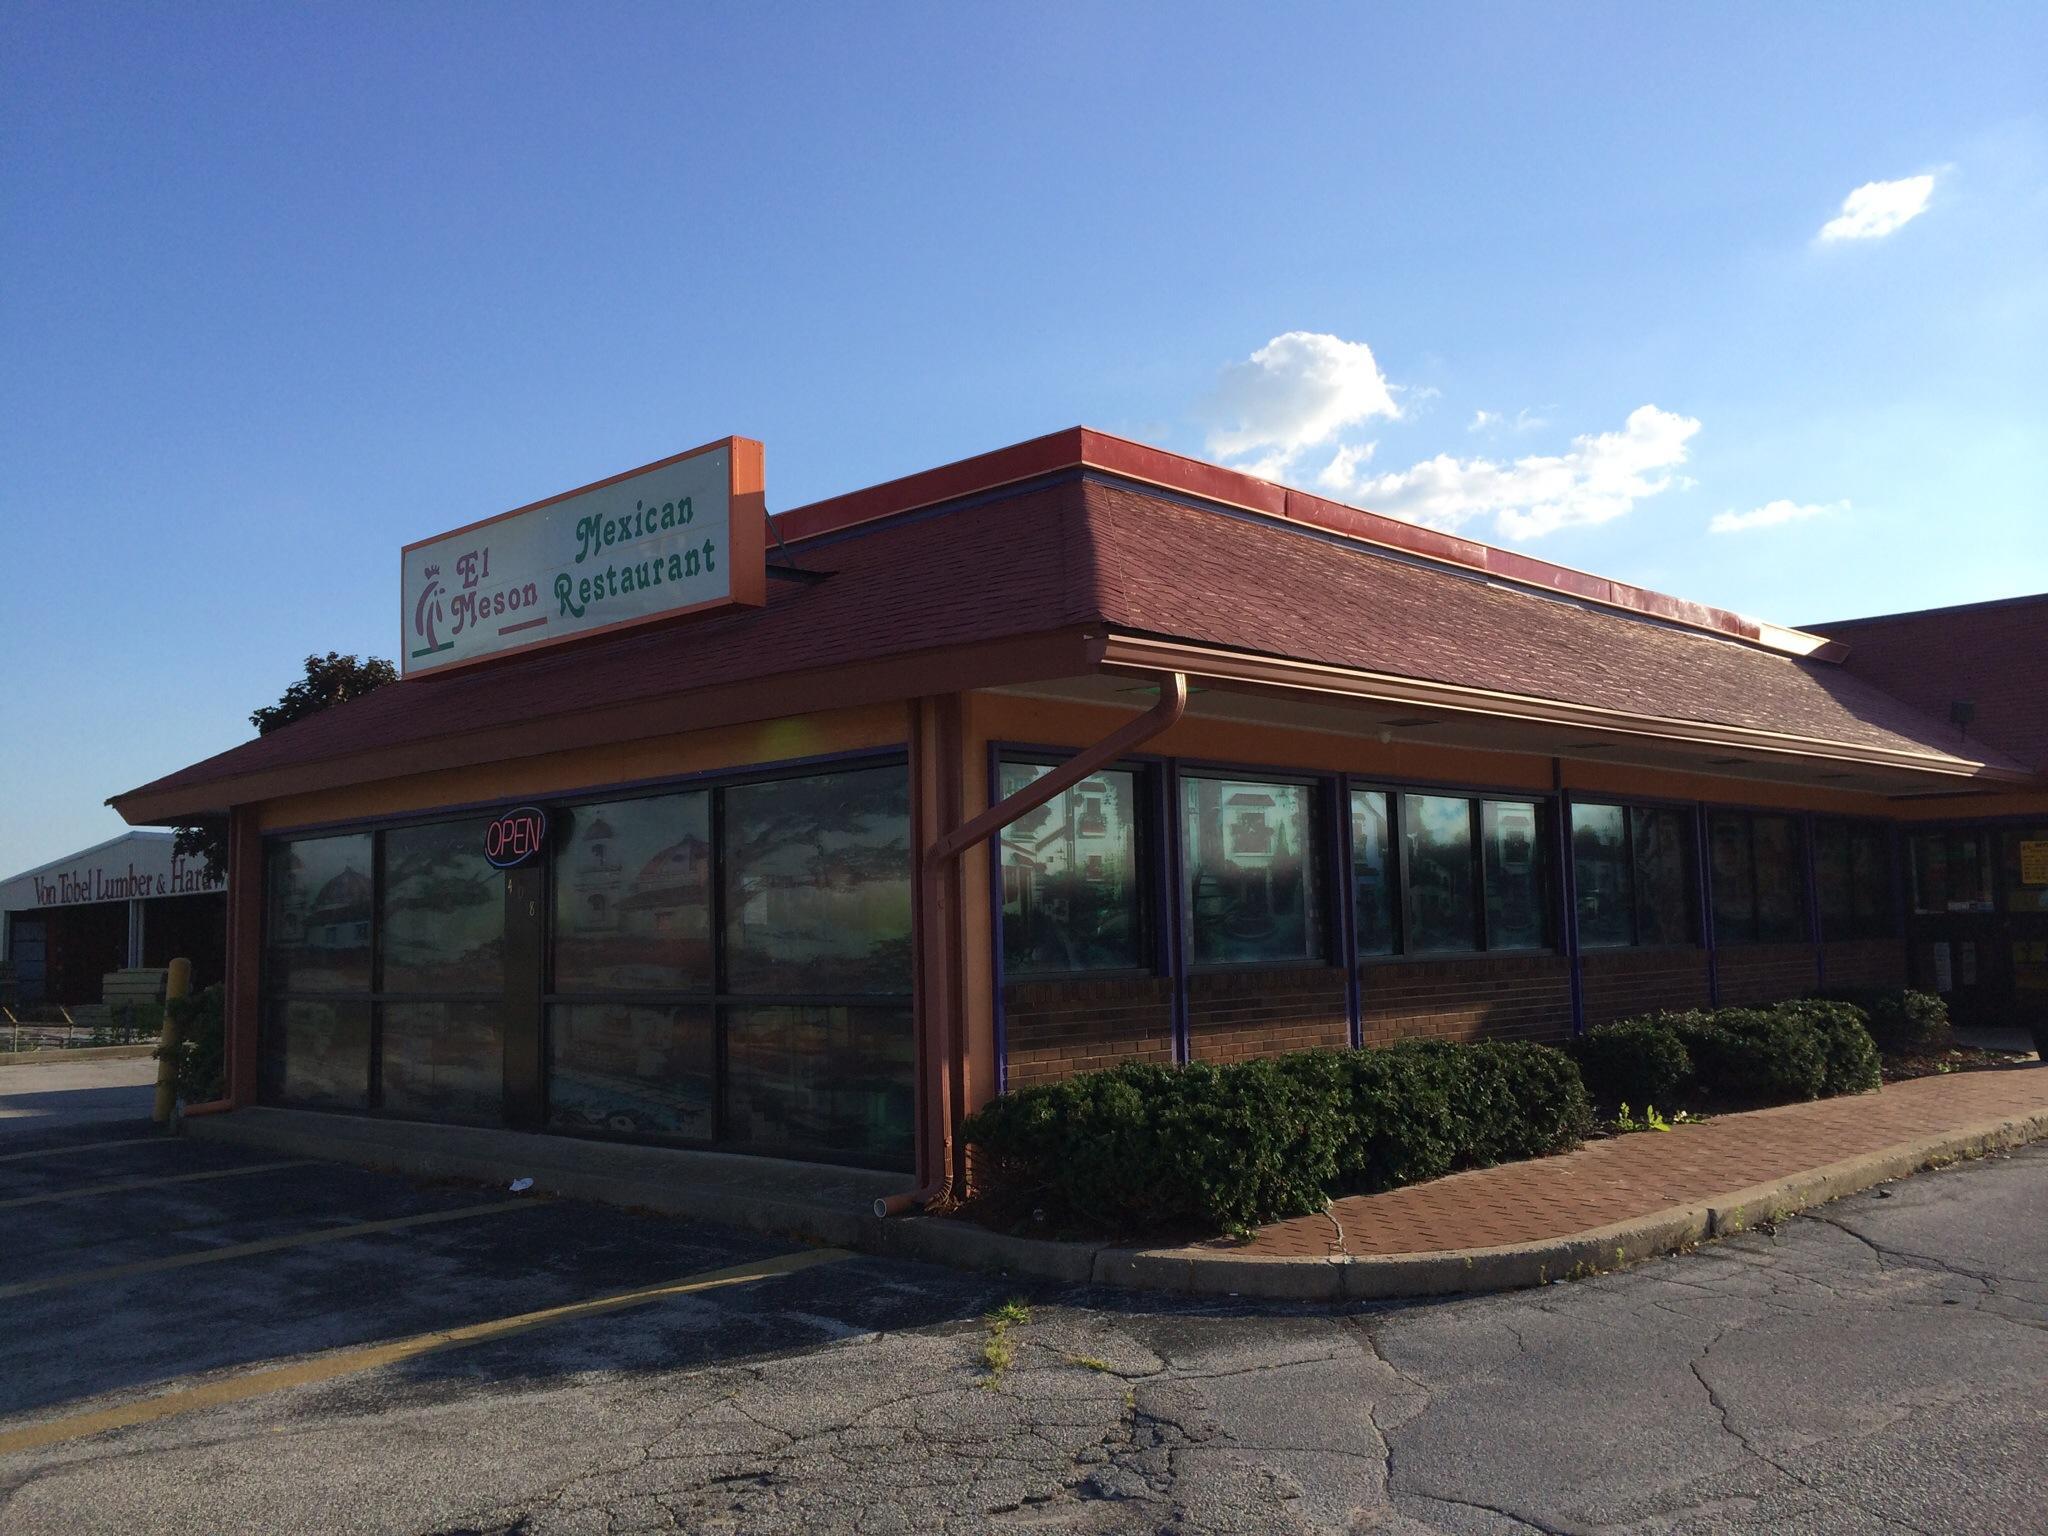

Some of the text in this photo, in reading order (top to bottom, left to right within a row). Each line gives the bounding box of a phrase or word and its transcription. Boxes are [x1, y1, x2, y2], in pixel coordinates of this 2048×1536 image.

[575, 495, 694, 563] Mexican
[456, 546, 490, 589] El
[554, 538, 716, 618] Restaurant
[451, 580, 538, 635] Meson
[487, 816, 541, 856] OPEN
[34, 877, 57, 905] Von
[58, 869, 92, 904] Tobel
[95, 863, 153, 901] Lumber
[155, 873, 167, 895] &
